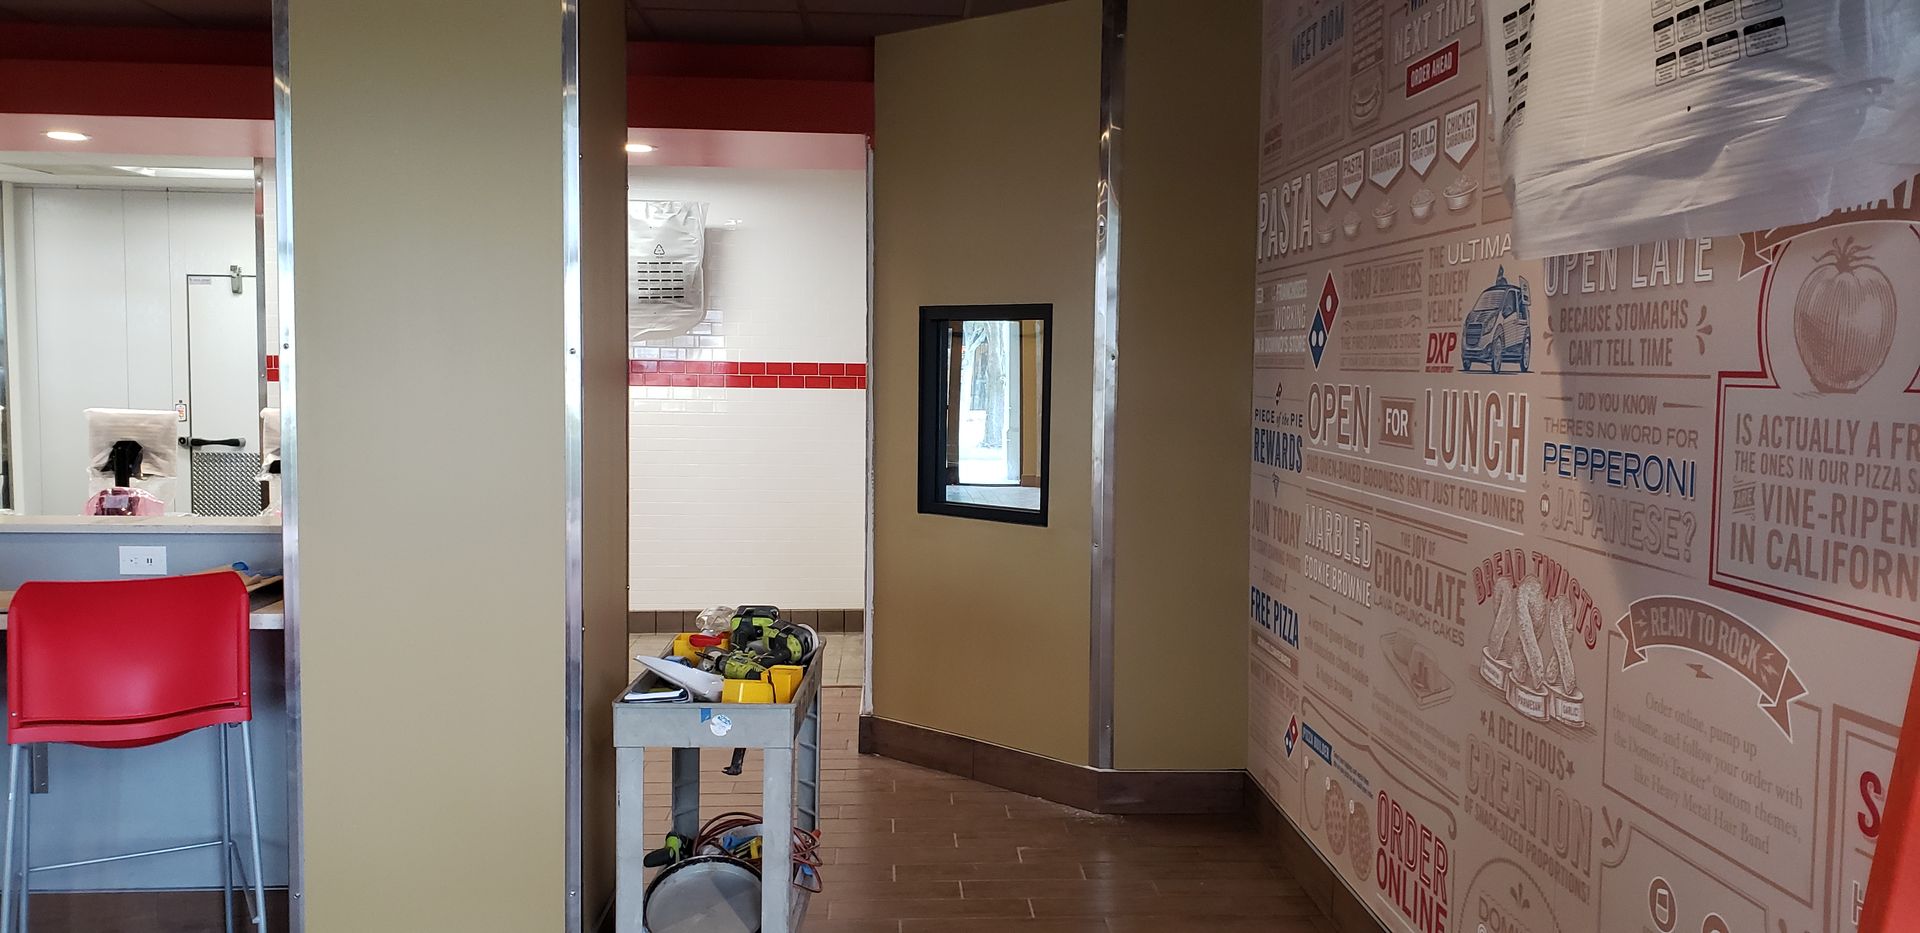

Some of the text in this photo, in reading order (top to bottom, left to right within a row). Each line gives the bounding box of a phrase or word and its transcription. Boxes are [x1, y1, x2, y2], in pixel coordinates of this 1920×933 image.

[1393, 14, 1431, 65] NEXT
[1436, 0, 1477, 42] TIME
[1410, 51, 1453, 88] ORDER AHEAD
[1411, 125, 1436, 150] BUILD
[1446, 107, 1476, 137] CHICKEN
[1257, 172, 1312, 260] PASTA
[1428, 269, 1470, 297] DELIVERY
[1429, 247, 1445, 270] THE
[1427, 298, 1463, 324] VEHICLE
[1560, 299, 1688, 333] BECAUSE STOMACHS
[1427, 331, 1457, 365] DXP
[1568, 338, 1673, 367] CAN'T TELL TIME
[1254, 408, 1275, 424] PIECE
[1290, 413, 1303, 428] PIE
[1307, 382, 1530, 481] OPEN FOR LUNCH
[1544, 417, 1698, 449] THERE'S NO WORD FOR
[1578, 393, 1658, 415] DID YOU KNOW
[1254, 428, 1303, 473] REWARDS
[1736, 413, 1753, 446] IS
[1758, 415, 1861, 456] ACTUALLY
[1867, 421, 1881, 458] A
[1306, 455, 1524, 525] OUR OVEN-BAKED GOODNESS ISN'T JUST FOR DINNER
[1542, 441, 1697, 499] PEPPERONI
[1735, 450, 1755, 474] THE
[1760, 453, 1794, 479] ONES
[1800, 457, 1813, 481] IN
[1819, 459, 1848, 486] OUR
[1854, 463, 1901, 492] PIZZA
[1252, 499, 1301, 549] JOIN TODAY
[1305, 503, 1373, 569] MARBLED
[1411, 533, 1427, 560] JOY
[1553, 486, 1697, 563] JAPANESE?
[1304, 554, 1330, 587] COOKIE
[1332, 566, 1372, 609] BROWNIE
[1374, 548, 1467, 627] CHOCOLATE
[1730, 522, 1920, 602] IN CALIFORN
[1251, 586, 1299, 650] FREE PIZZA
[1394, 602, 1431, 632] CRUNCH
[1432, 619, 1466, 648] CAKES
[1473, 549, 1602, 650] BREAD TWISTS
[1651, 607, 1762, 674] READY TO ROCK
[1488, 711, 1495, 739] A
[1500, 716, 1566, 780] DELICIOUS
[1646, 692, 1758, 762] Order online, pump up
[1612, 704, 1626, 721] the
[1662, 731, 1680, 750] and
[1682, 735, 1713, 765] follow
[1714, 756, 1739, 781] your
[1741, 770, 1772, 795] order
[1775, 782, 1803, 809] with
[1466, 733, 1592, 878] CREATION
[1614, 730, 1627, 748] the
[1712, 784, 1751, 815] custom
[1754, 803, 1801, 843] themes,
[1634, 764, 1770, 854] like Heavy Metal Hair Band
[1377, 790, 1448, 906] ORDER
[1376, 848, 1448, 933] ONLINE
